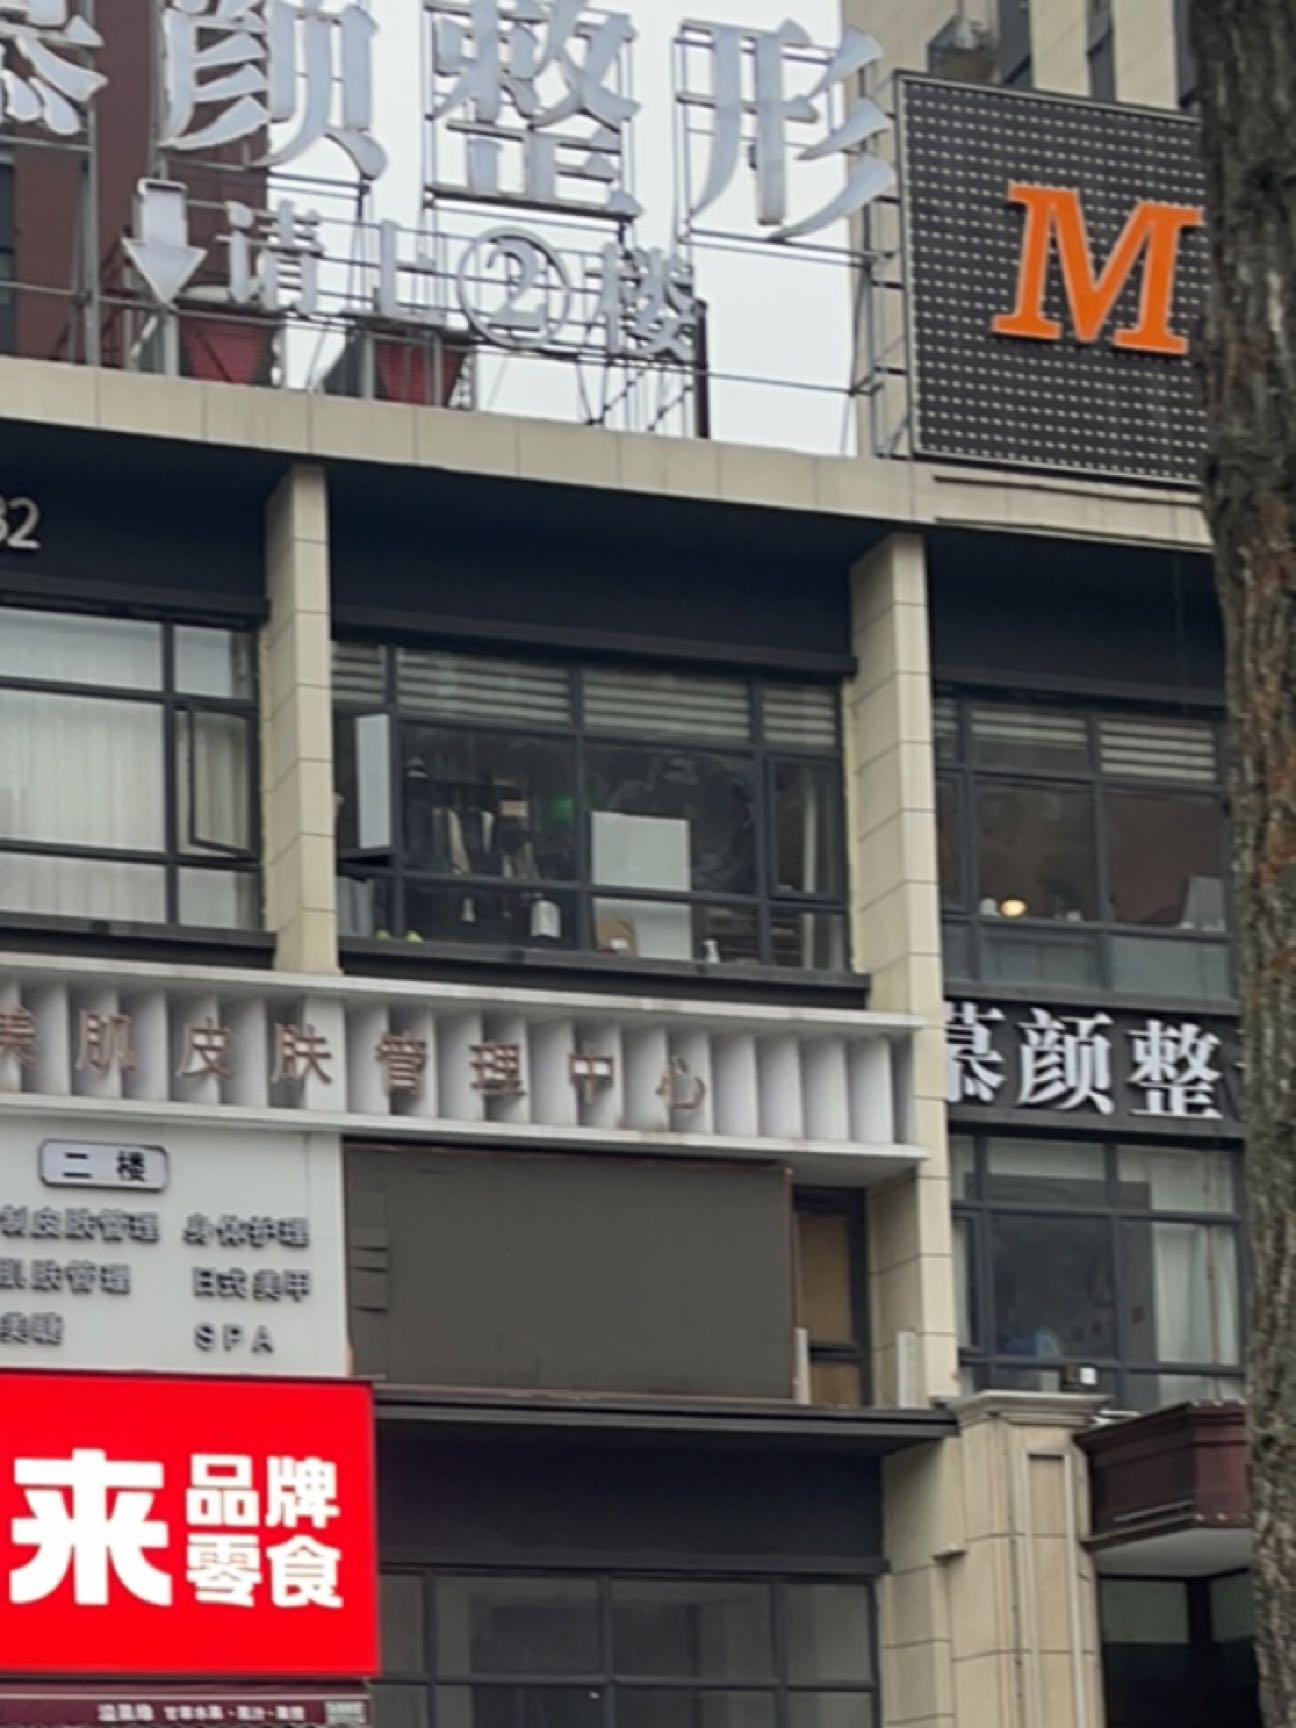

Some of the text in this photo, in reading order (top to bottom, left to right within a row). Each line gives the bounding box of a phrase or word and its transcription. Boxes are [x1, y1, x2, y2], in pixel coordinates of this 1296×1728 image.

[992, 181, 1204, 355] M
[945, 1002, 1249, 1118] 慕颜整
[186, 1453, 340, 1528] 品牌
[187, 1534, 344, 1608] 零食
